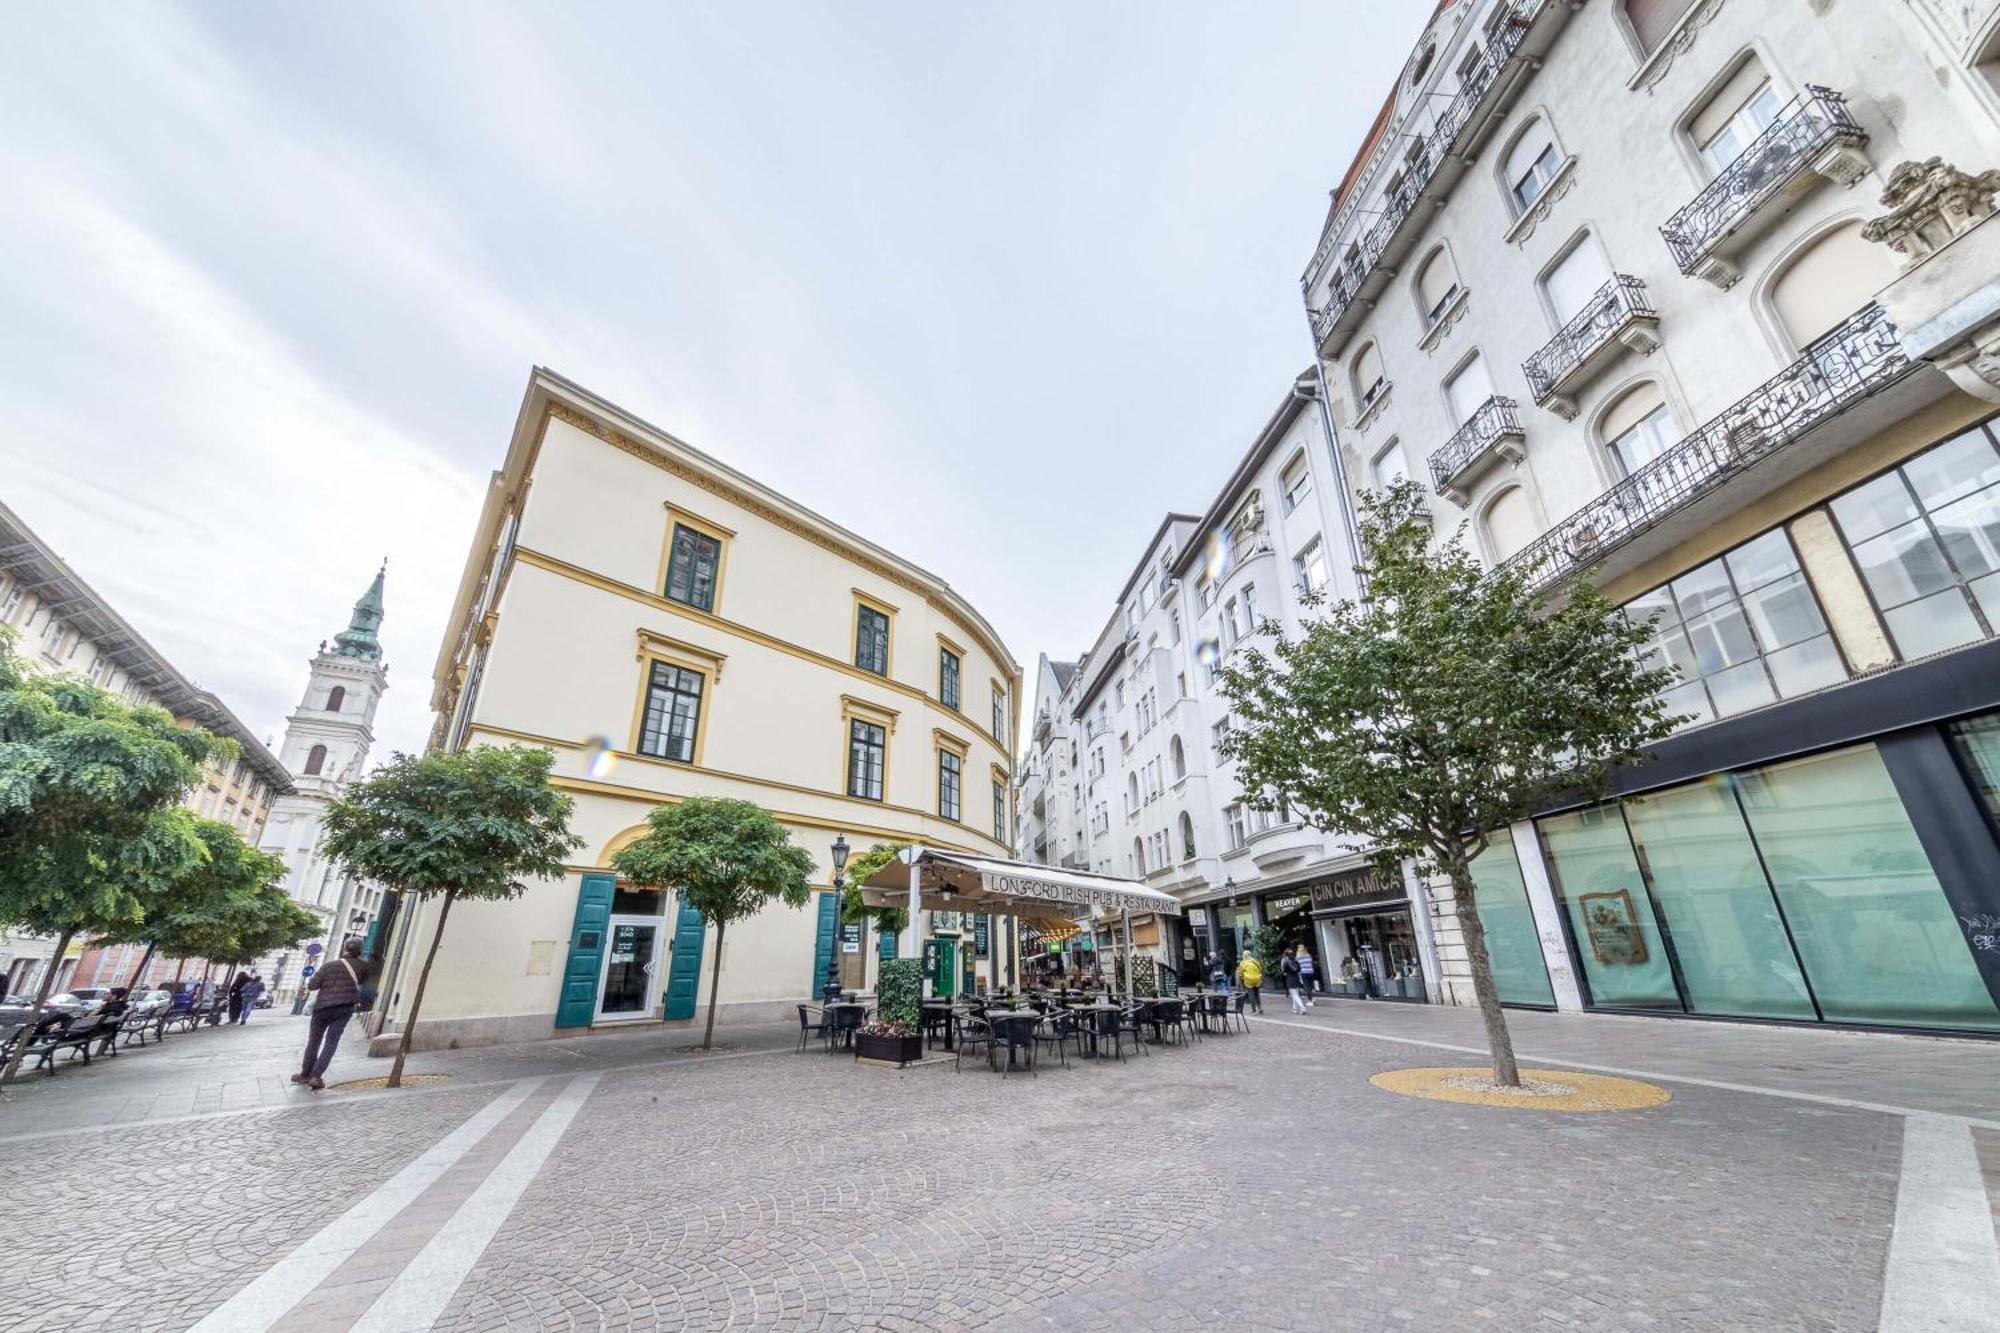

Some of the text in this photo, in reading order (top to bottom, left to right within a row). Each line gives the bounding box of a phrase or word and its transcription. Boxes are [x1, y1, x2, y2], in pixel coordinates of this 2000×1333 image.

[1062, 886, 1090, 903] IRISH
[1092, 890, 1112, 906] PUB
[1314, 871, 1401, 901] CIN CIN AMICA
